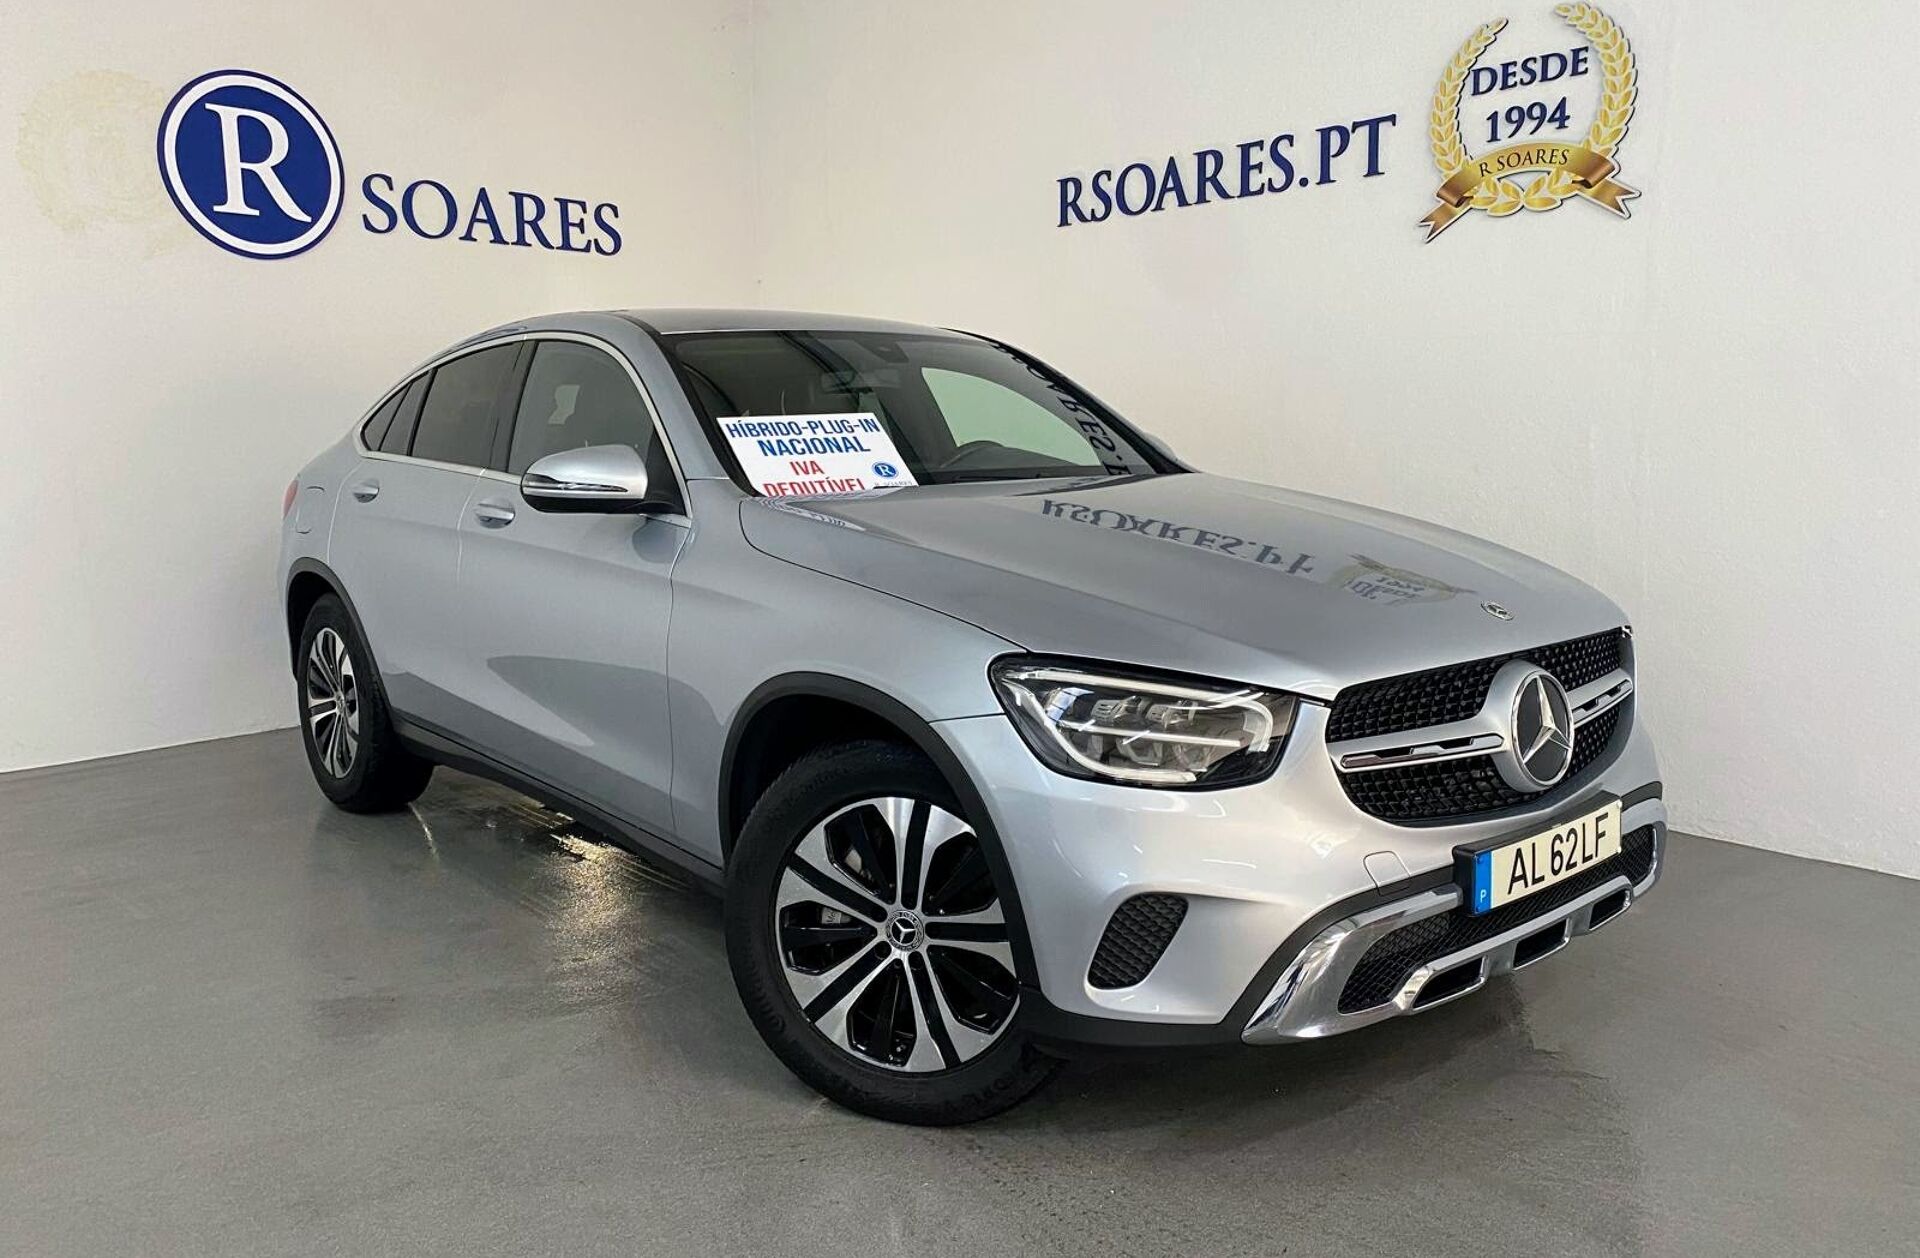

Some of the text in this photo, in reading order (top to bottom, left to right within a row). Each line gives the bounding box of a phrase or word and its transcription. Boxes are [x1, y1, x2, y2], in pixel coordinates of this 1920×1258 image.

[1470, 46, 1590, 97] DESDE
[1485, 96, 1572, 143] 1994
[1056, 114, 1397, 228] RSOARES.PT
[1479, 148, 1570, 179] R SOARES
[204, 102, 624, 257] R SOARES
[726, 418, 881, 438] HÍBRIDO-PLUG-IN
[757, 436, 871, 456] NACIONAL
[789, 460, 825, 476] IVA
[1480, 889, 1487, 902] P
